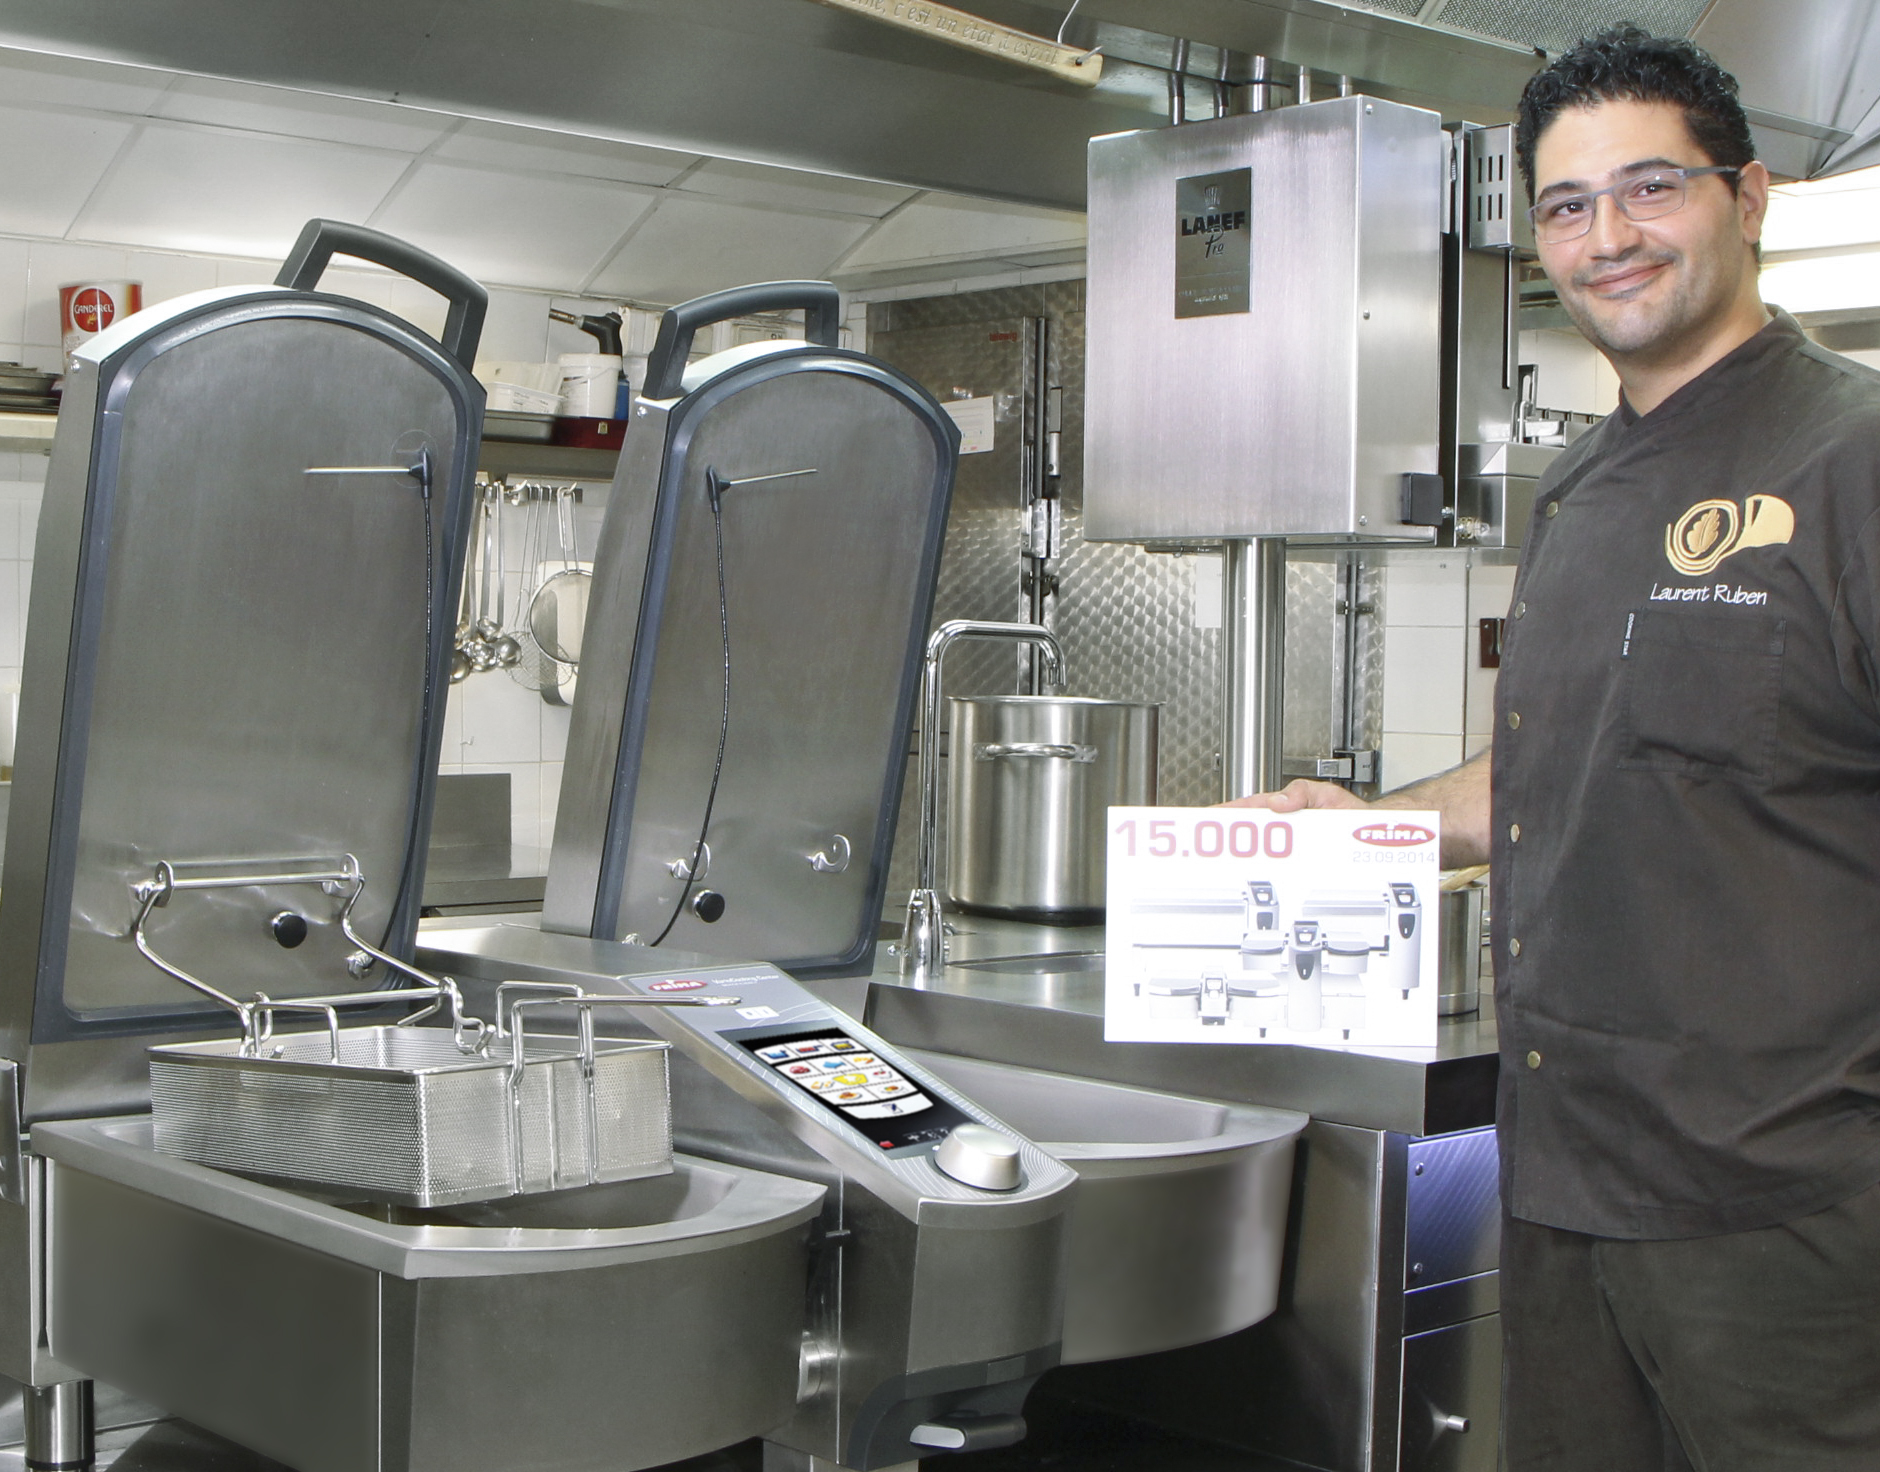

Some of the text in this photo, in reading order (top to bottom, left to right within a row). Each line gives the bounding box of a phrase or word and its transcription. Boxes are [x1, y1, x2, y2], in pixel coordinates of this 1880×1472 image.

[936, 15, 958, 34] un
[1204, 225, 1224, 258] Pro
[1650, 583, 1767, 605] Laurent Ruben
[1115, 820, 1293, 858] 15.000
[1360, 820, 1428, 841] FRIMA
[653, 979, 702, 990] FRIMA
